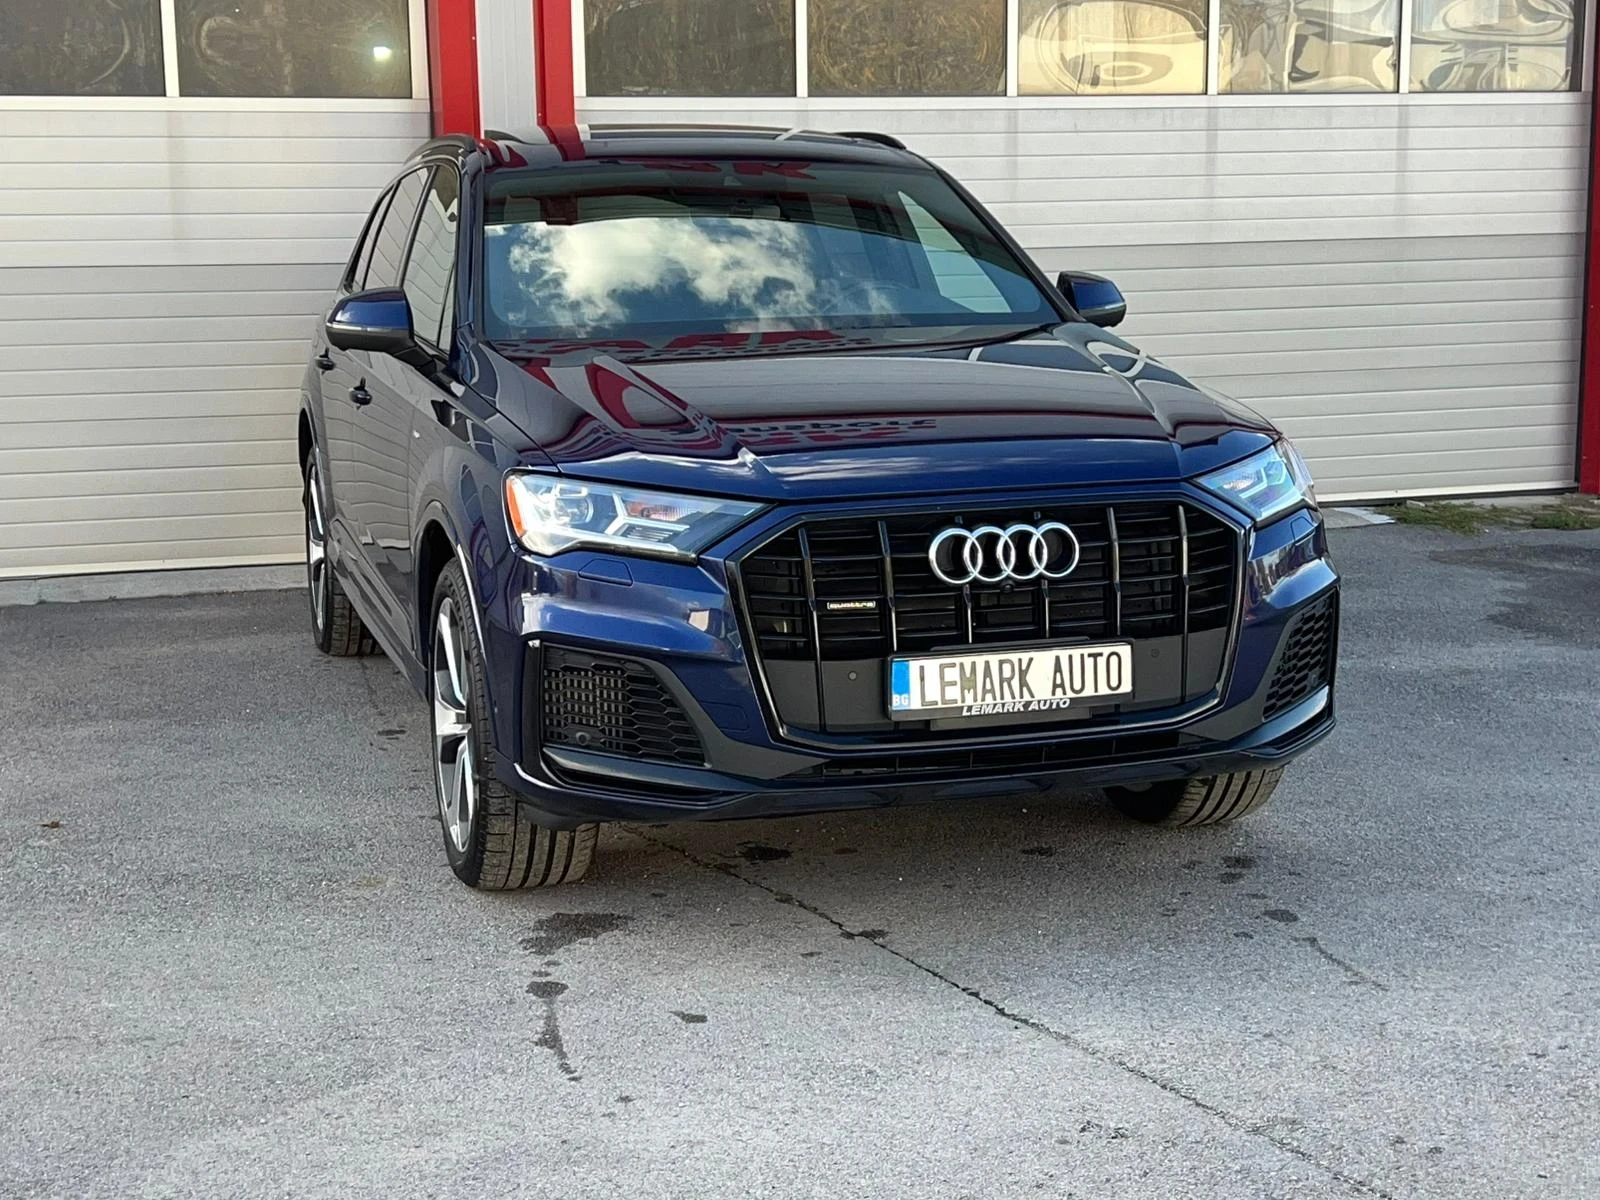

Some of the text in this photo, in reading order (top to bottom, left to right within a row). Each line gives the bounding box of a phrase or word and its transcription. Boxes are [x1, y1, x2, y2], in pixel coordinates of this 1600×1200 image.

[919, 651, 1123, 707] LEMARK AUTO
[892, 694, 909, 706] BG
[962, 698, 1071, 716] LEMARK AUTO
